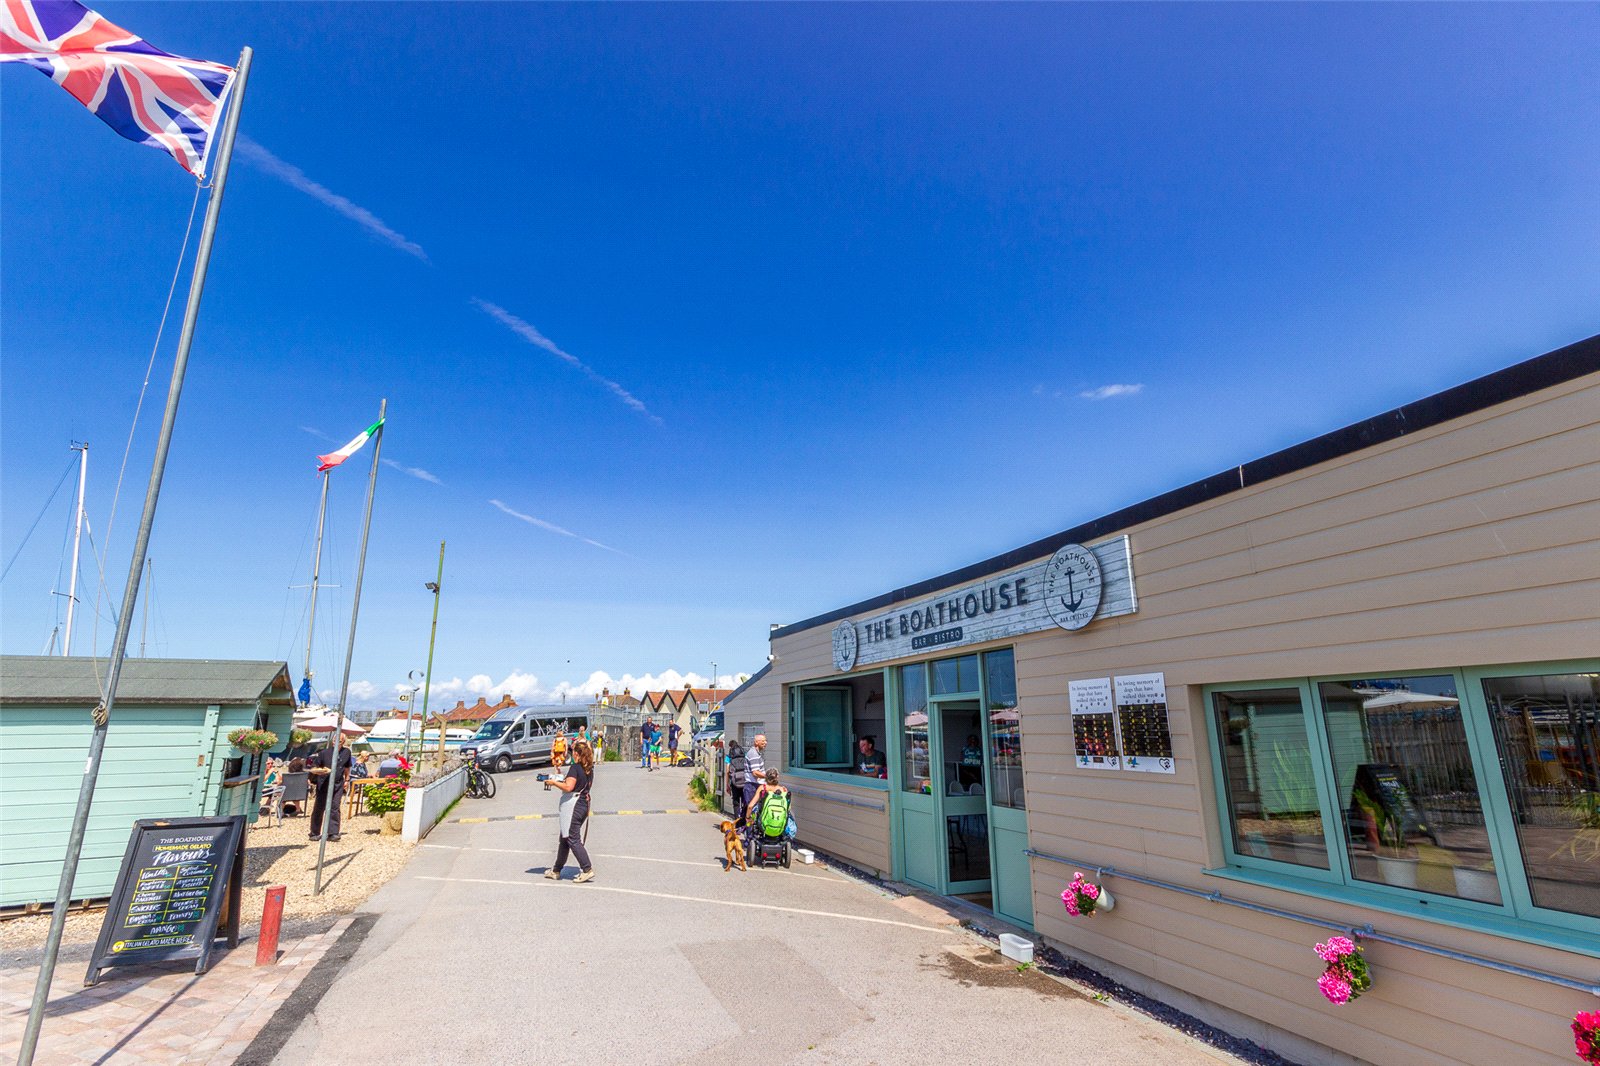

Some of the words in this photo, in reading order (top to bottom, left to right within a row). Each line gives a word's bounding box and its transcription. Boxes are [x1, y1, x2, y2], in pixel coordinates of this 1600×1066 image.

[1055, 552, 1095, 584] BOATHOUSE
[865, 618, 895, 644] THE
[900, 577, 1029, 636] BOATHOUSE
[914, 637, 928, 648] BAR
[934, 630, 961, 643] BISTRO
[174, 835, 214, 843] BOATHOUSE
[152, 849, 215, 867] Flavours
